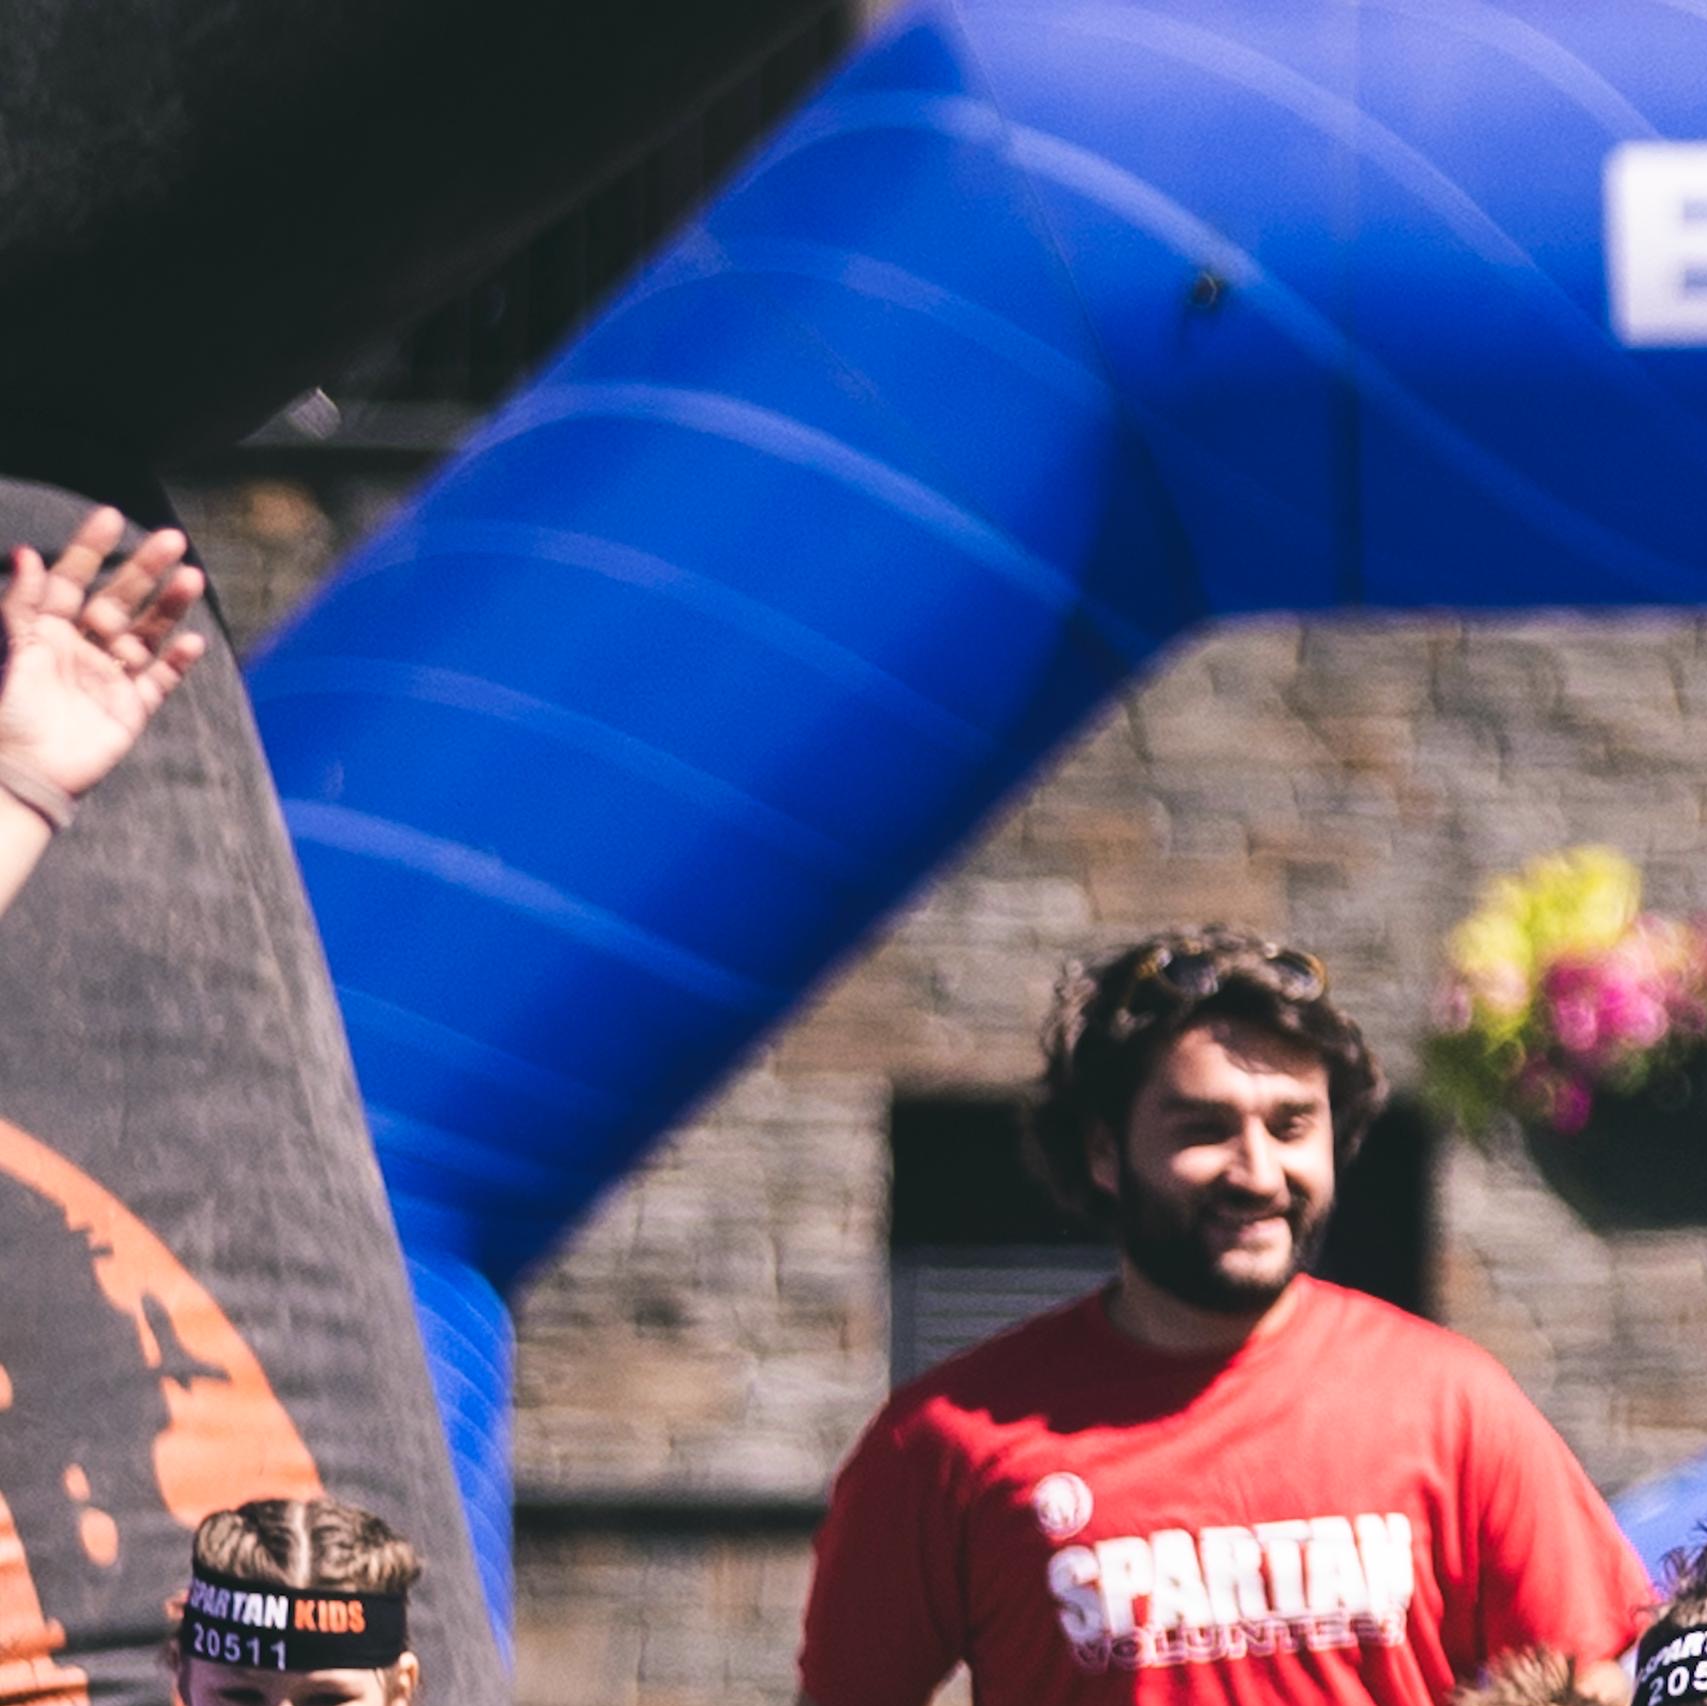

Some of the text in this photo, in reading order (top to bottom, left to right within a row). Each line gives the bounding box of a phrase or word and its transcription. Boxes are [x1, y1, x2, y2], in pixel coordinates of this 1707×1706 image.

[189, 1577, 367, 1633] SPARTAN KIDS
[1047, 1512, 1414, 1648] SPARTAN
[193, 1622, 287, 1671] 20511
